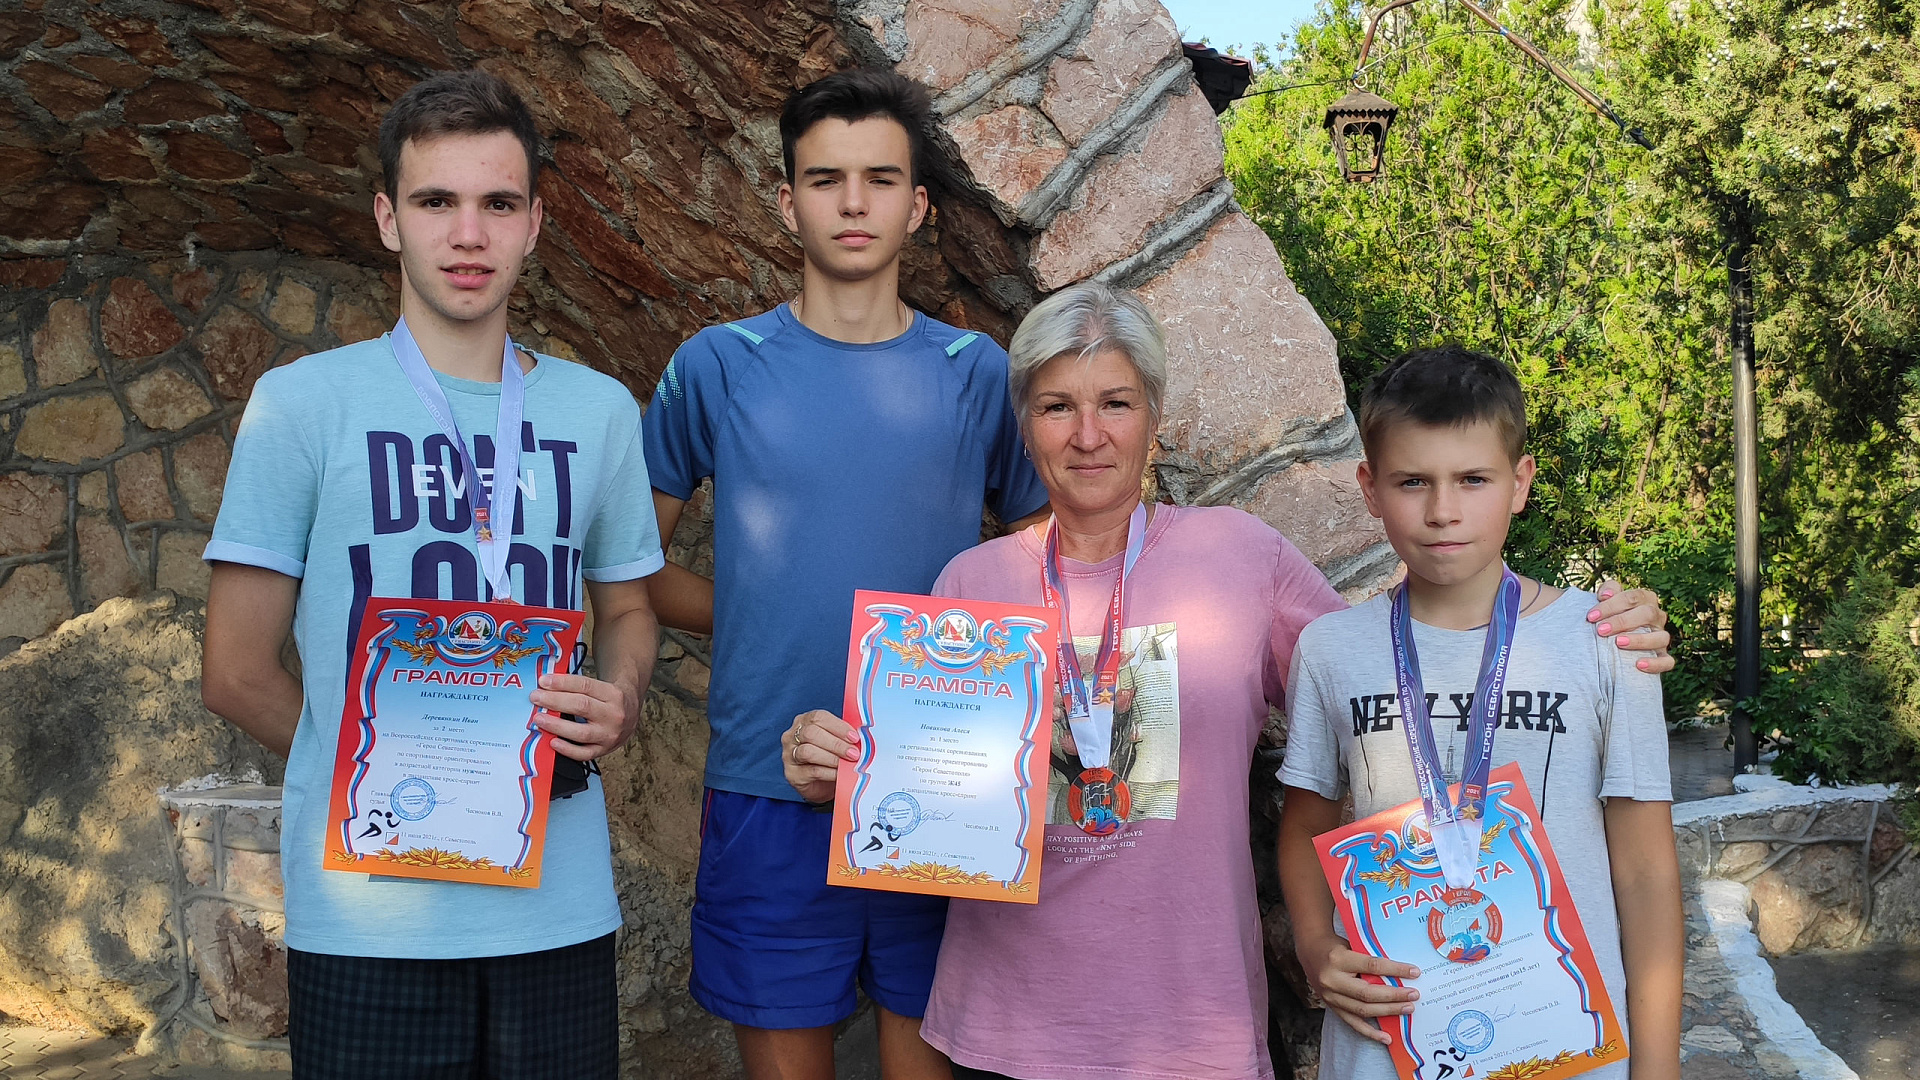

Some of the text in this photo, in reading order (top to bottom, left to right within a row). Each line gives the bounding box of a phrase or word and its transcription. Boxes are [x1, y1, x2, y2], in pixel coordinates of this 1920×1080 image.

[412, 464, 537, 501] EVEN
[392, 668, 524, 689] ГРАМОТА
[886, 672, 1014, 700] ГРАМОТА
[420, 691, 490, 702] НАГРАЖДАЕТСЯ
[914, 698, 981, 712] НАГРАЖДАЕТСЯ
[1481, 645, 1508, 760] ГЕРОИ СЕВАСТОПОЛЯ
[1450, 691, 1569, 734] YRK
[1096, 844, 1118, 852] NNY
[1119, 841, 1137, 849] SIDE
[1380, 860, 1516, 919] ГРАМТА
